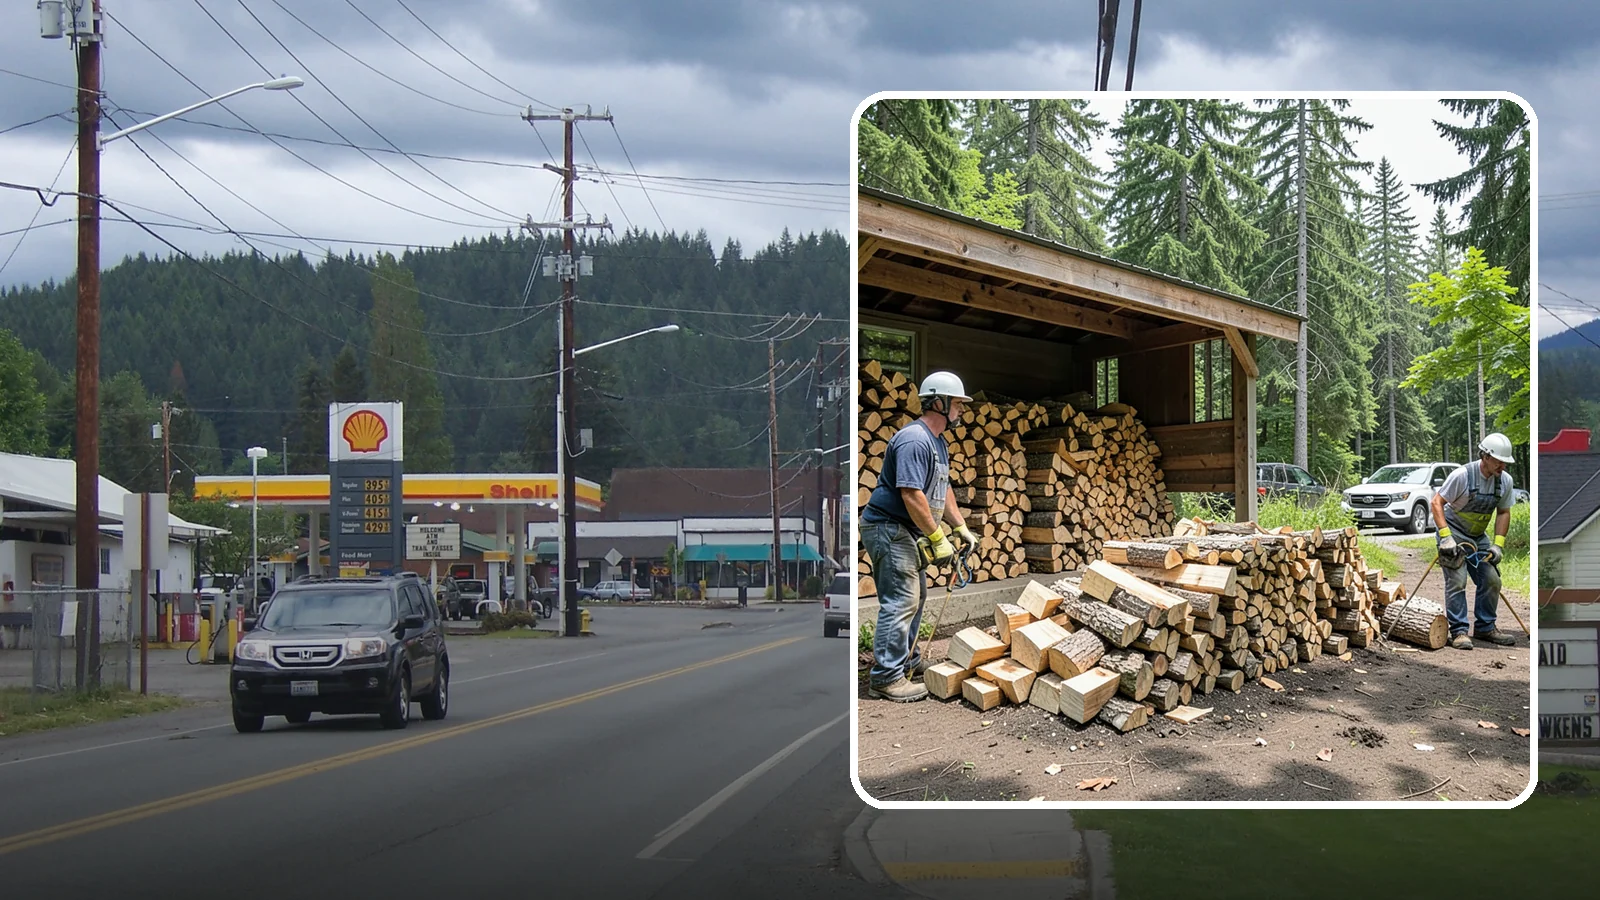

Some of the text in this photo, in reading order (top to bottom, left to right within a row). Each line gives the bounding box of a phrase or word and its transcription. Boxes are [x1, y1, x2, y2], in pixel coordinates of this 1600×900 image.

[365, 480, 383, 490] 395
[490, 484, 547, 499] Shell
[365, 494, 383, 504] 405
[365, 508, 383, 518] 415
[365, 522, 383, 532] 429
[1538, 643, 1567, 665] AID
